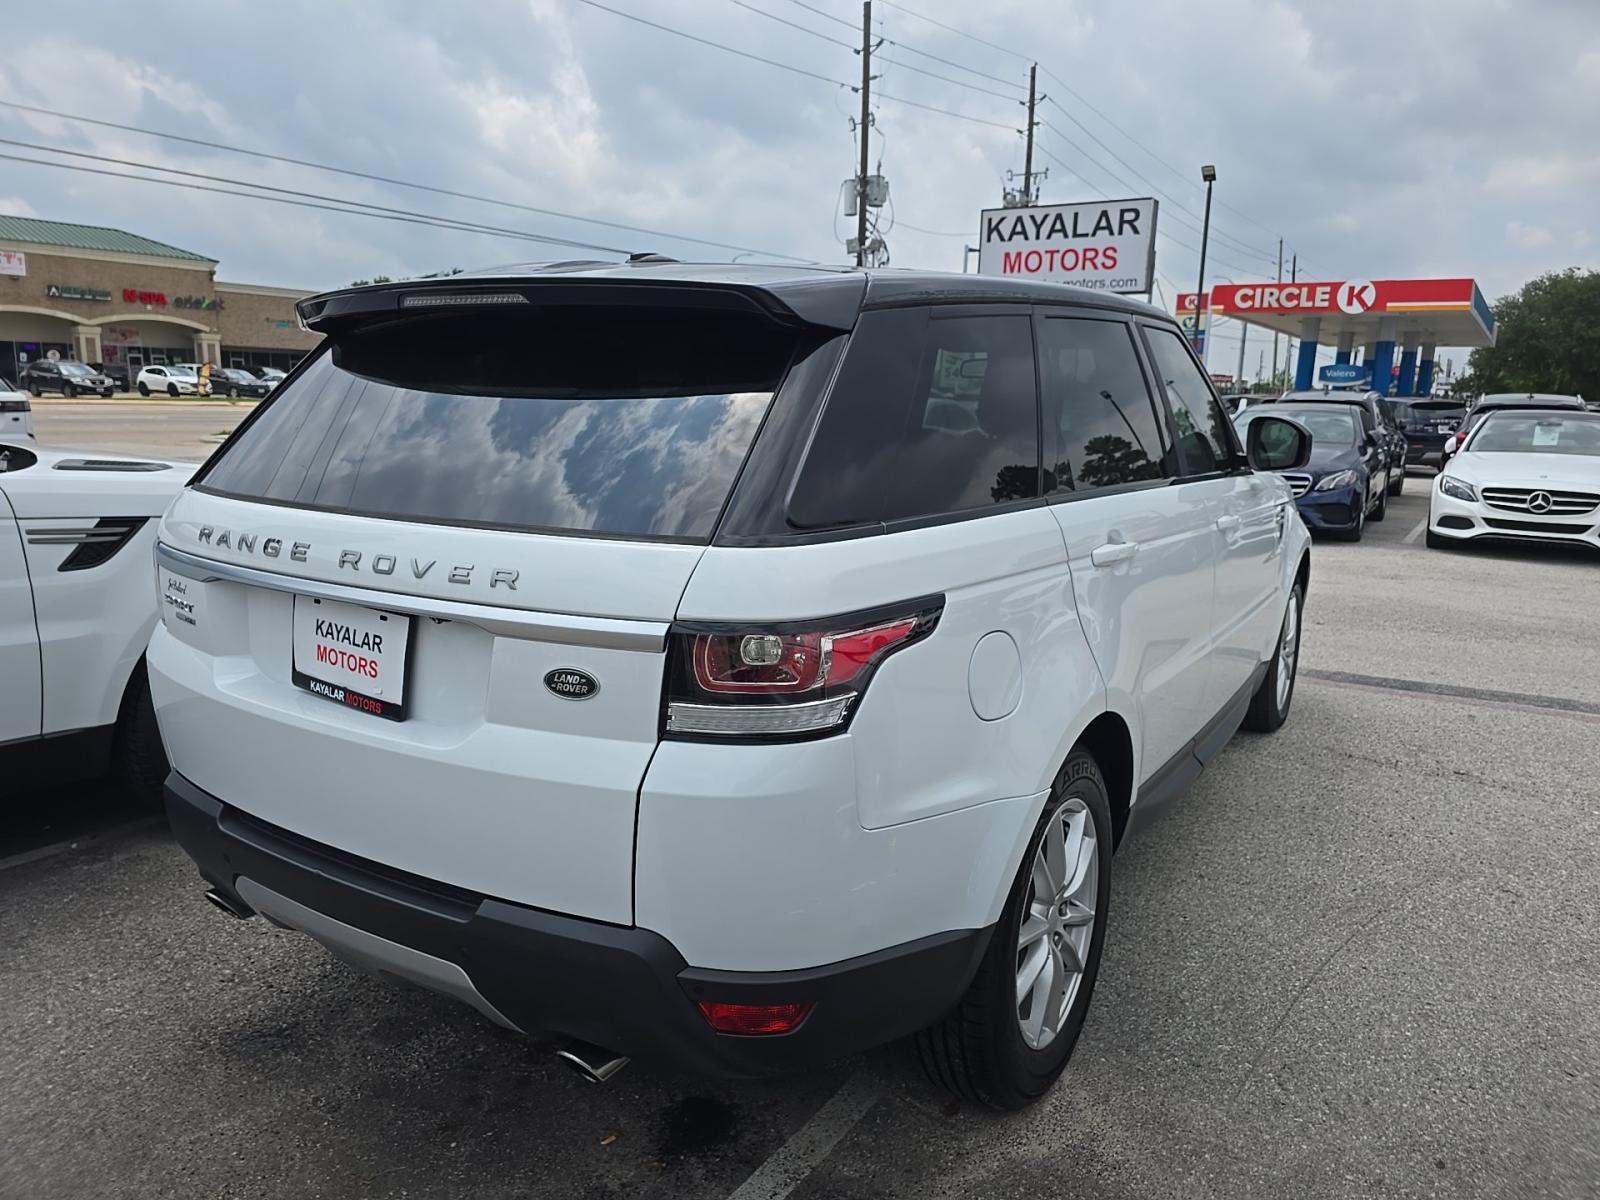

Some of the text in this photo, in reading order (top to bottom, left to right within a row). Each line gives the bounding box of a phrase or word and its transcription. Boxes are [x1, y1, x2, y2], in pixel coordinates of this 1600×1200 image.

[986, 208, 1141, 243] KAYALAR
[1003, 247, 1118, 275] MOTORS
[1234, 286, 1331, 309] CIRCLE
[1325, 369, 1356, 378] Valero
[198, 526, 520, 591] RANGE ROVER
[315, 618, 383, 654] KAYALAR
[316, 644, 378, 679] MOTORS
[310, 680, 382, 714] KAYALAR MOTORS
